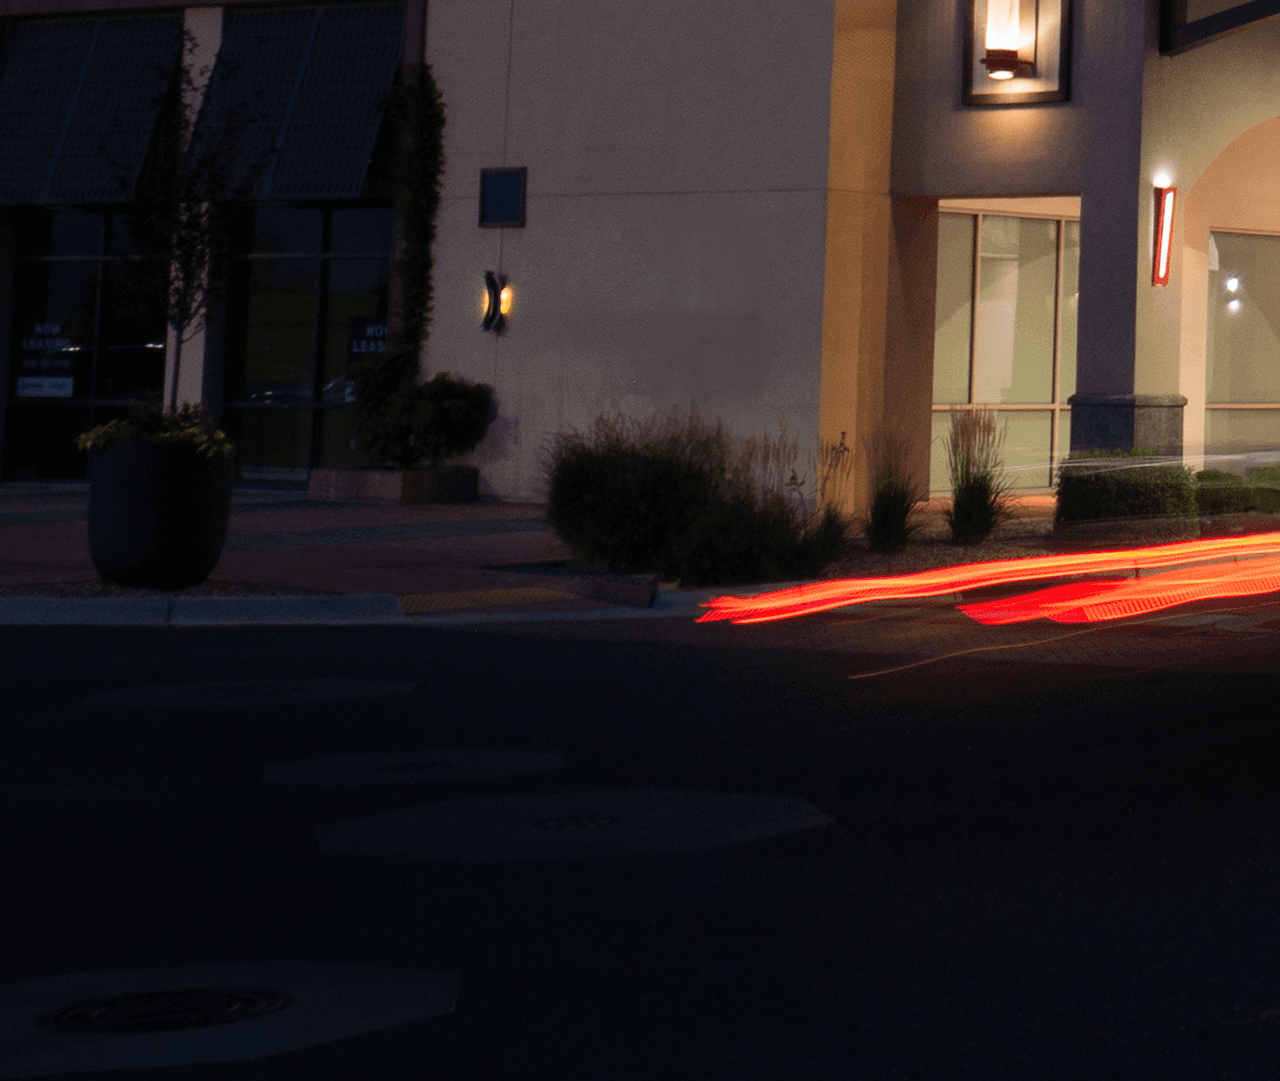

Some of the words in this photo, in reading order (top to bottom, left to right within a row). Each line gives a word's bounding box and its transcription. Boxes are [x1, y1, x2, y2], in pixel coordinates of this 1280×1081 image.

[35, 324, 62, 335] NOW
[366, 324, 388, 337] NO
[22, 338, 72, 350] LEASING
[352, 340, 386, 352] LEAS
